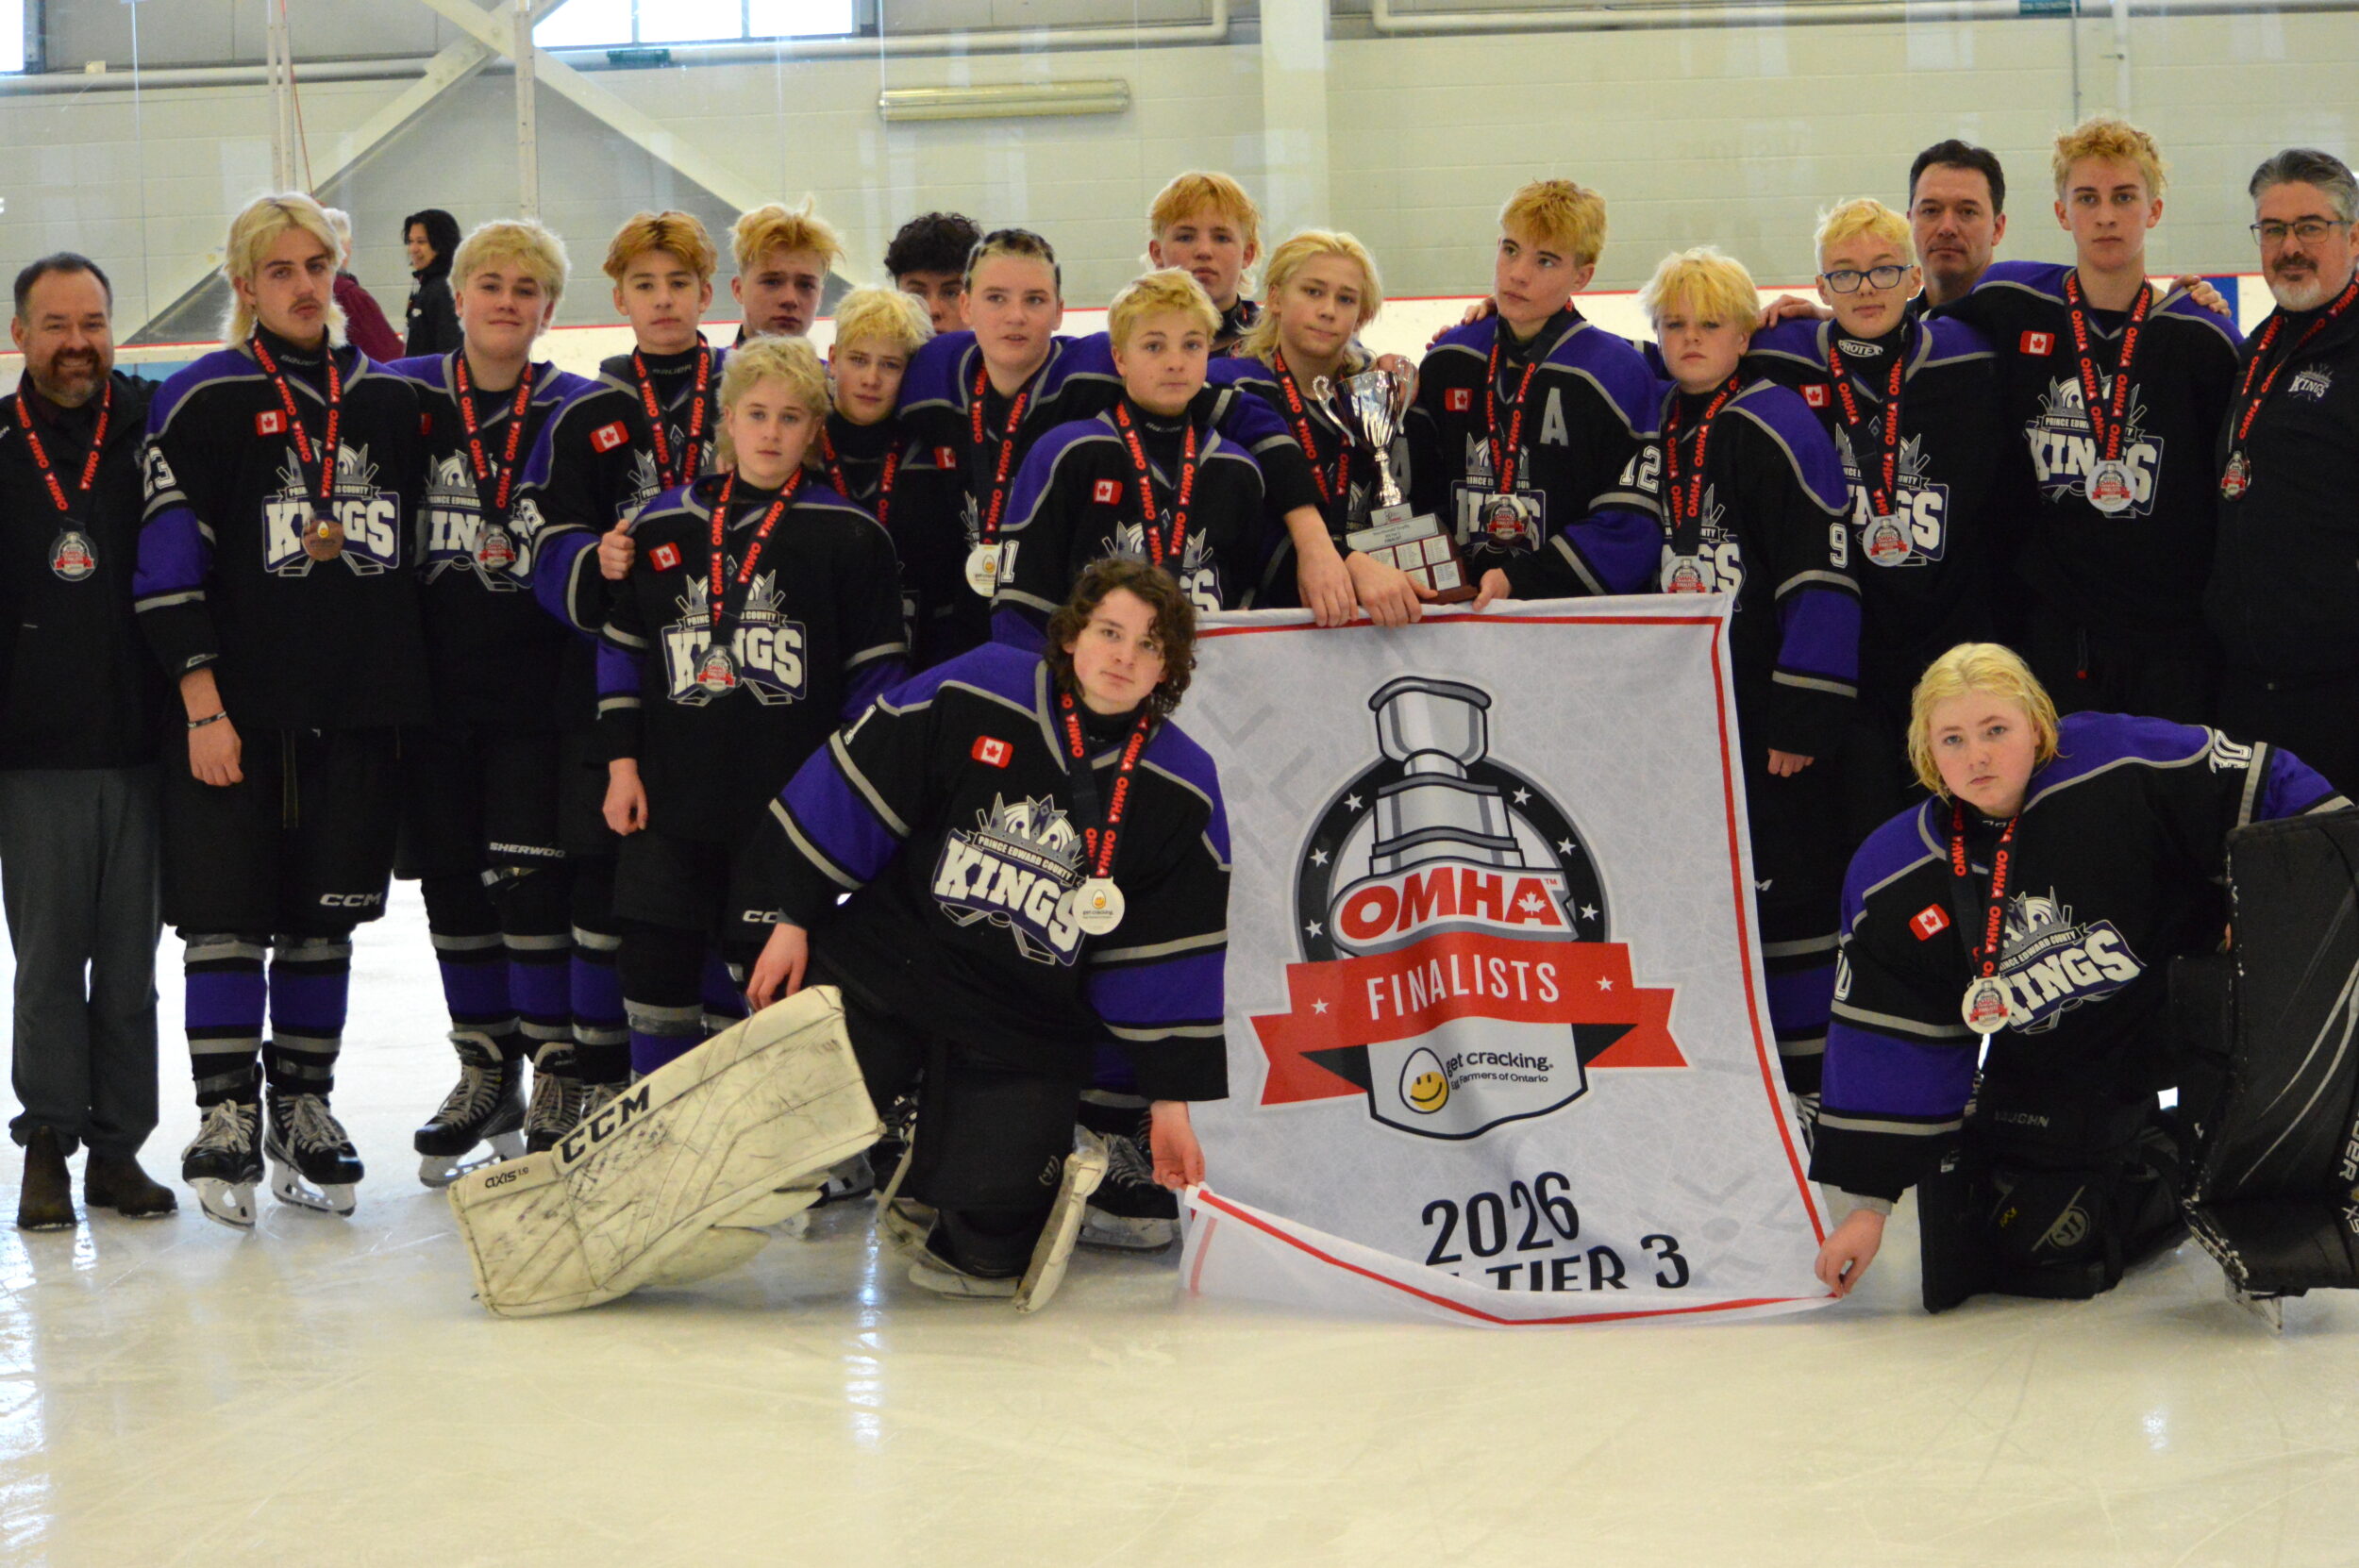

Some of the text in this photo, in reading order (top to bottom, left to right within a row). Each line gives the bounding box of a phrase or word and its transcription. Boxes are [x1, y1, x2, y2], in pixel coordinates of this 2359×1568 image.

[2070, 309, 2088, 353] OMHA
[2080, 358, 2098, 401] OMHA
[2112, 375, 2128, 417] OMHA
[2288, 375, 2326, 397] KINGS
[1540, 386, 1569, 446] A
[1884, 401, 1899, 446] OMHA
[1619, 445, 1661, 493] 12
[2026, 428, 2157, 503] KINS
[1829, 523, 1849, 568] 9
[1065, 713, 1084, 759] OMHA
[1096, 732, 1144, 878] OMHA OMHA OMHA
[979, 835, 1073, 880] PRINCE EDWARD COUNTY
[1951, 835, 1966, 876] OMHA
[1991, 850, 2009, 898] OMHA
[319, 892, 384, 908] CCM
[742, 909, 778, 924] CC
[934, 837, 1081, 952] KINGS
[1340, 866, 1563, 940] OMHA
[1984, 906, 2001, 954] OMHA
[2018, 940, 2050, 962] EDWARD
[2050, 930, 2077, 948] COUNTY
[1366, 954, 1560, 1021] FINALISTS
[1446, 1052, 1464, 1077] get
[1459, 1072, 1497, 1085] Farmers
[1498, 1073, 1509, 1081] of
[1510, 1073, 1548, 1083] Ontario
[560, 1084, 650, 1163] CCM
[1421, 1171, 1580, 1266] 2026
[1485, 1233, 1690, 1292] TIER 3
